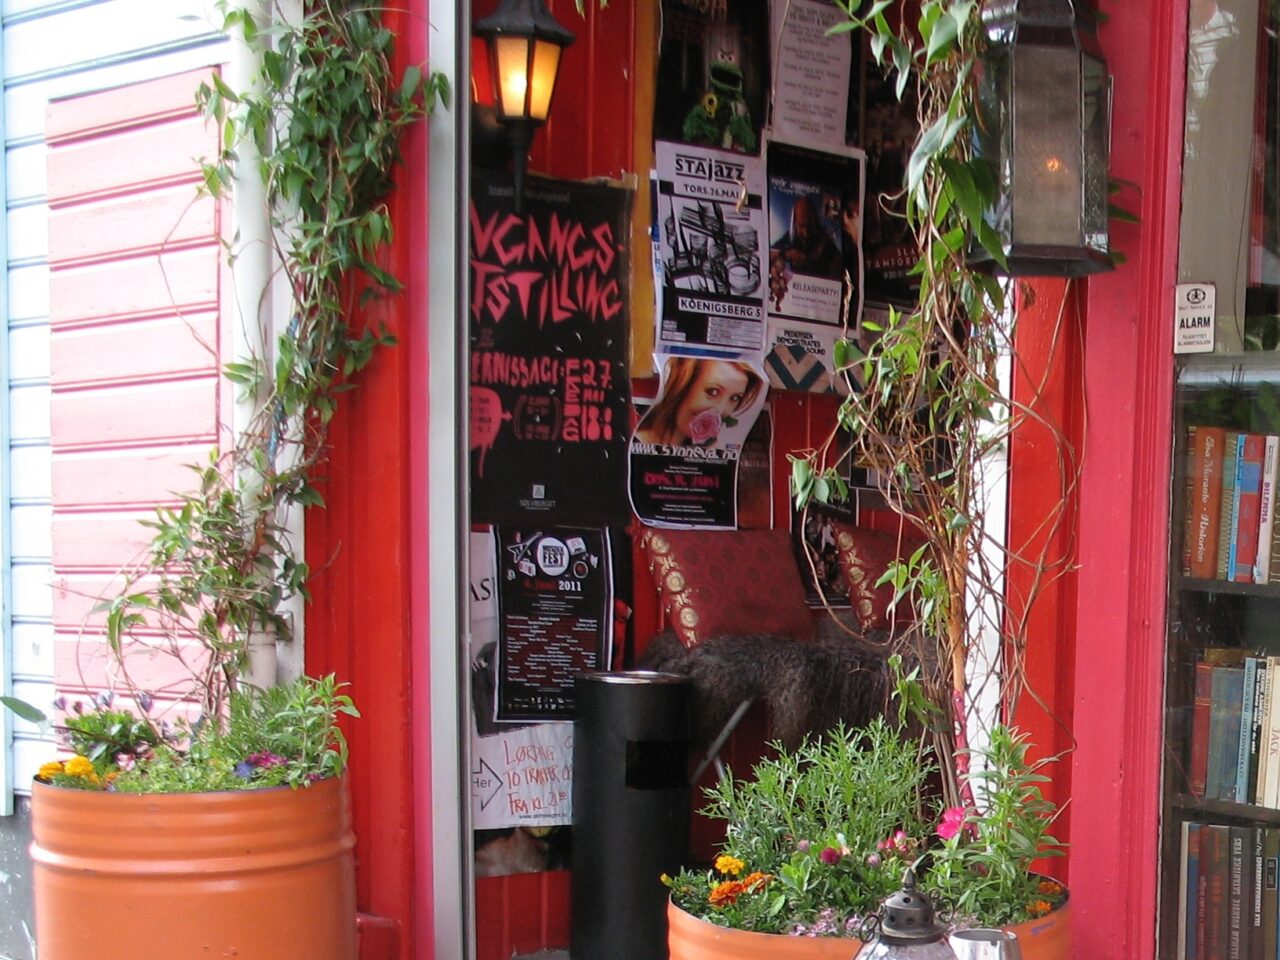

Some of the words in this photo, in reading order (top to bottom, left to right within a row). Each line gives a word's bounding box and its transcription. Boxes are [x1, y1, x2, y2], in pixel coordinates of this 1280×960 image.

[676, 157, 745, 181] STAjazz
[1180, 316, 1210, 329] ALARM
[777, 337, 821, 347] DEMONSTRATES
[1201, 459, 1213, 503] Morante
[1261, 482, 1271, 524] DILEMMA
[1197, 514, 1209, 562] Historien
[543, 553, 563, 565] FEST
[559, 580, 581, 591] 2011
[1270, 728, 1280, 756] JACK
[1233, 838, 1242, 855] VERS
[1232, 858, 1241, 895] SATANISKE
[1231, 931, 1240, 960] SALMAN
